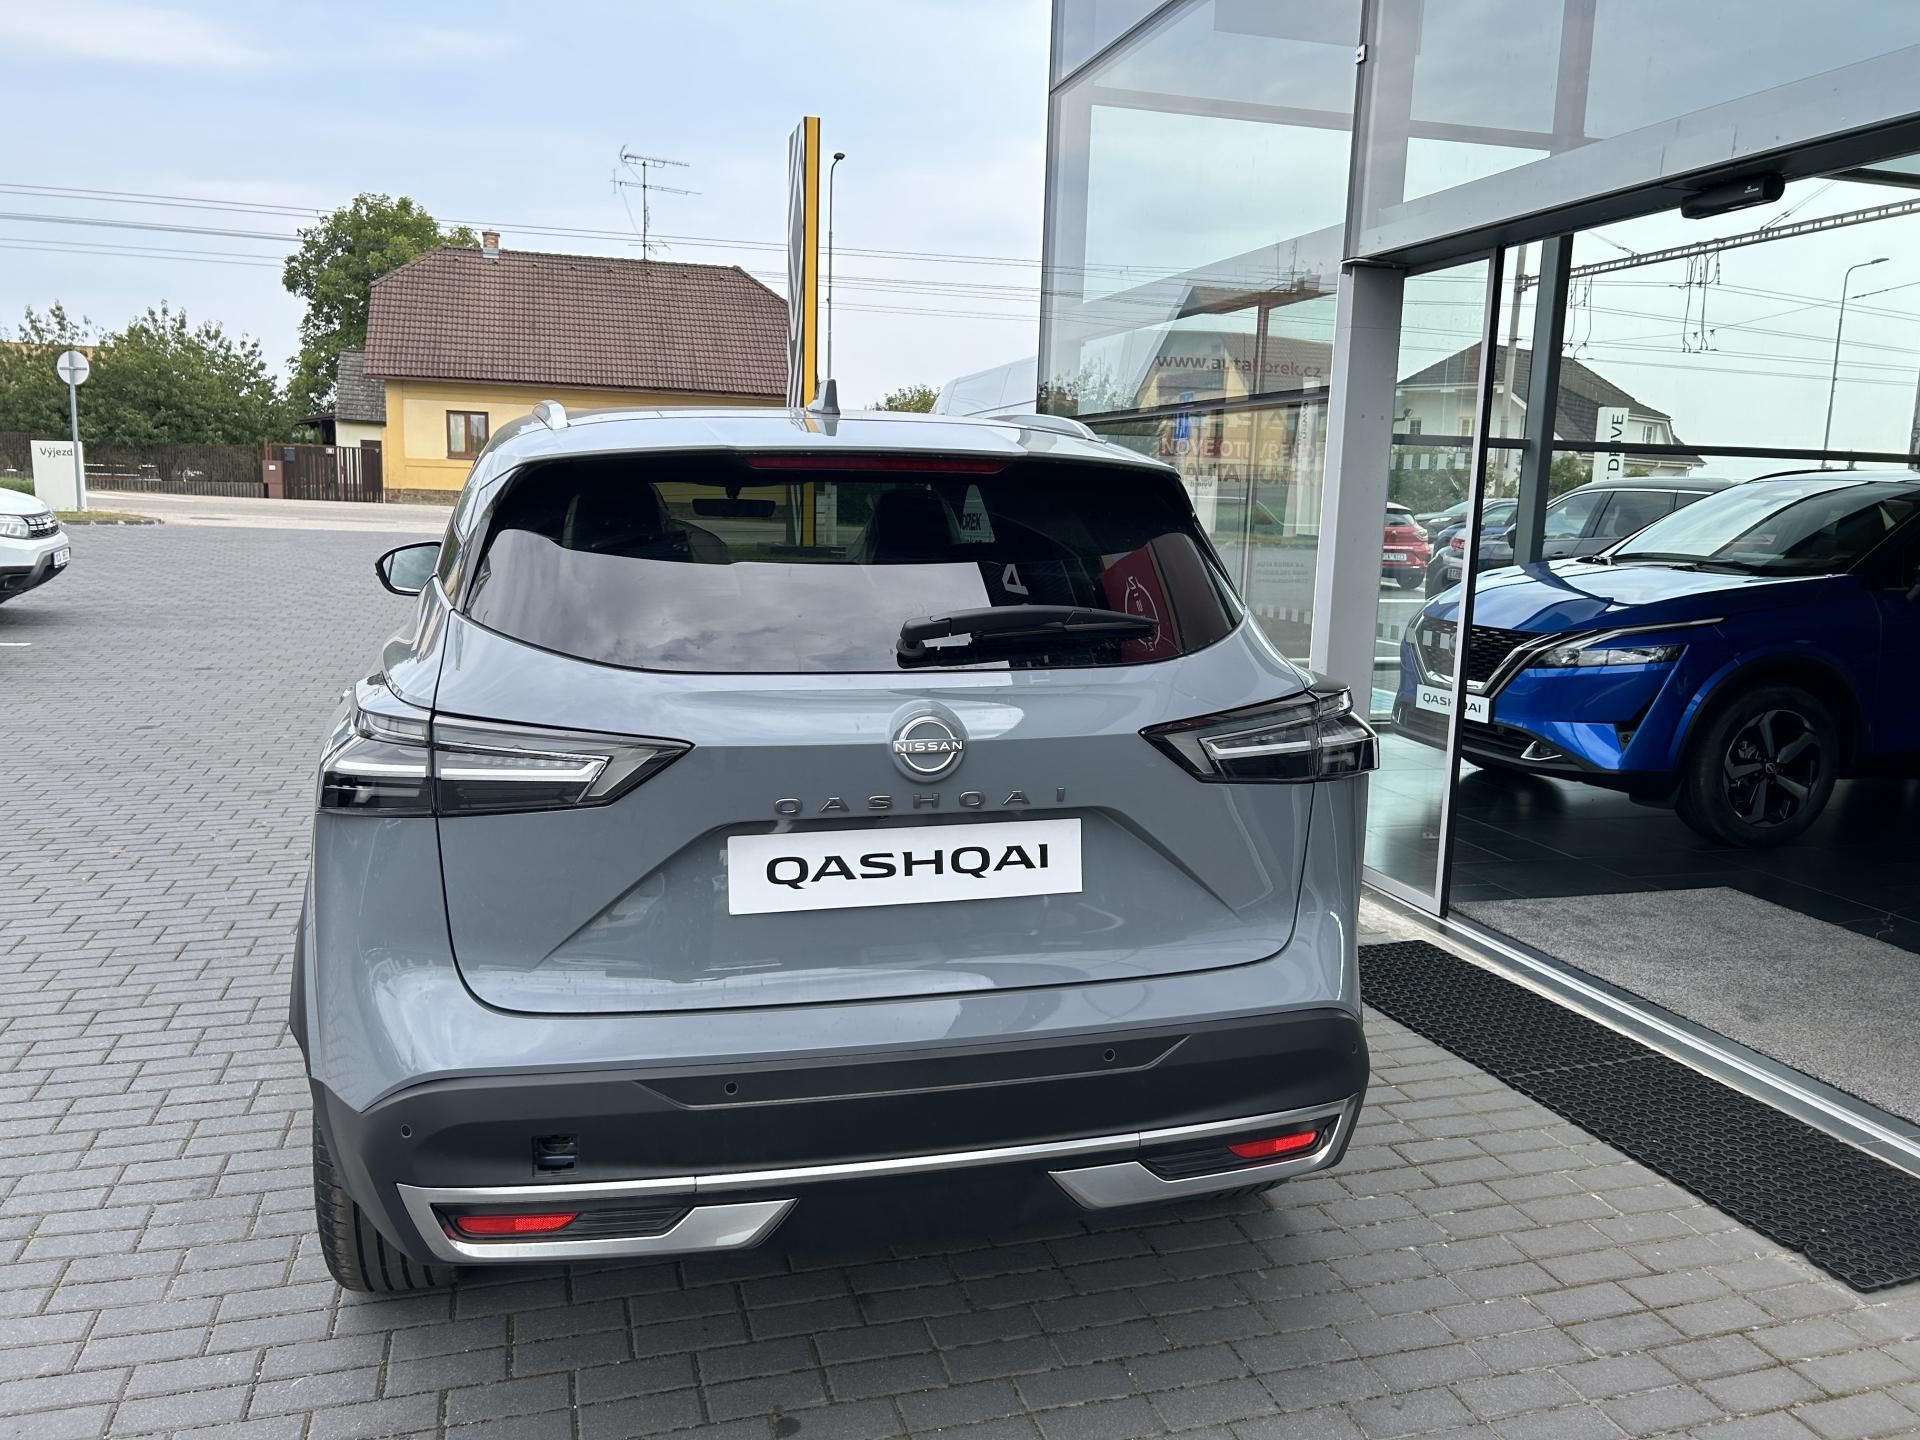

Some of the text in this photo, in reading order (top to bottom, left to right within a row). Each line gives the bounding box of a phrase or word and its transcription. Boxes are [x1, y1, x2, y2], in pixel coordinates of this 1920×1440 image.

[40, 447, 73, 458] Výjezd
[1608, 414, 1624, 471] DIVE
[1422, 692, 1482, 713] QASAI
[894, 739, 963, 752] NISSAN
[774, 787, 1066, 816] QASHQAI
[766, 843, 1049, 890] QASHQAI
